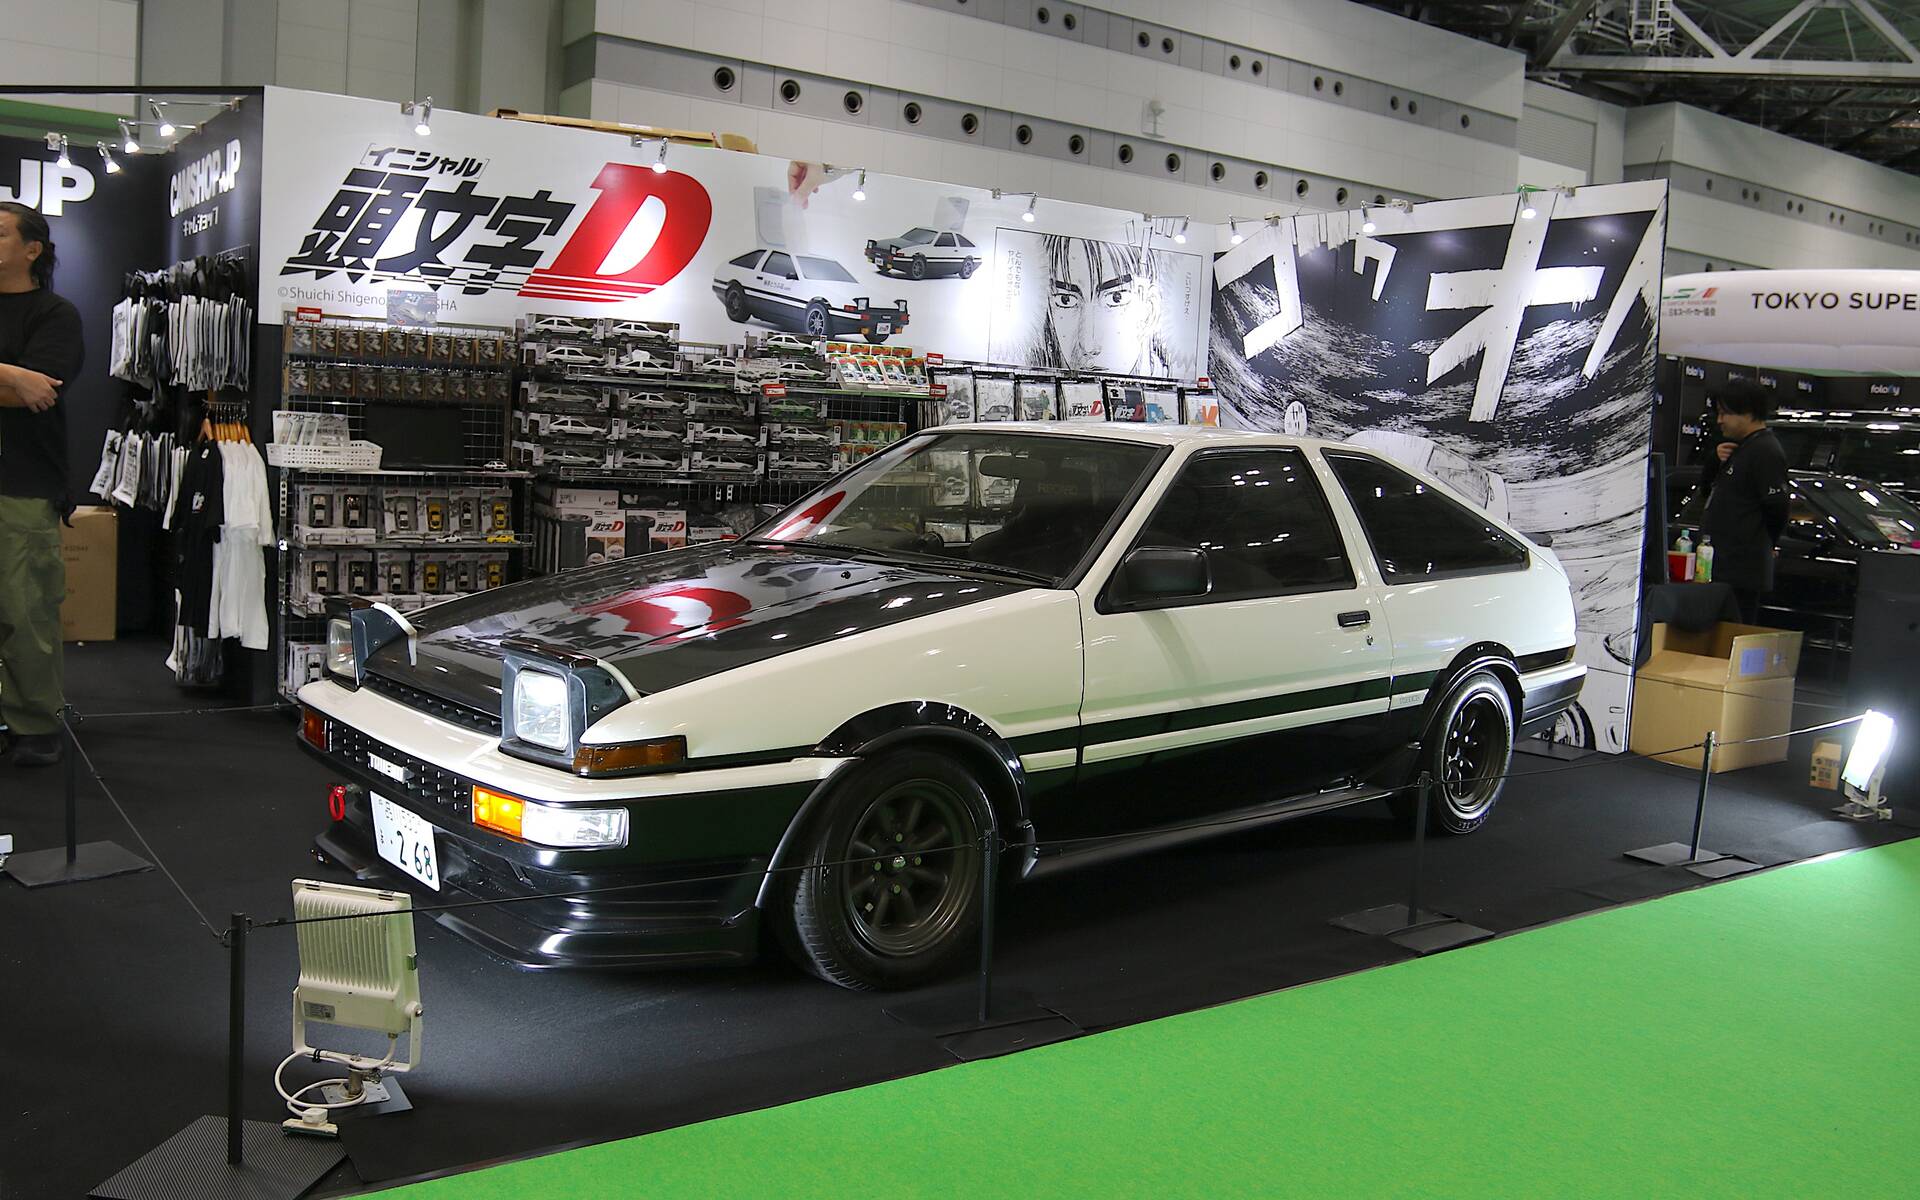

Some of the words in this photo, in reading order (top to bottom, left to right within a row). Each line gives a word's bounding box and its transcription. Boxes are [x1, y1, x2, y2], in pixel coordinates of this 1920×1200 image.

[170, 139, 241, 217] CAMSHOP.JP
[338, 291, 386, 307] Shigeno
[1751, 292, 1839, 310] TOKYO
